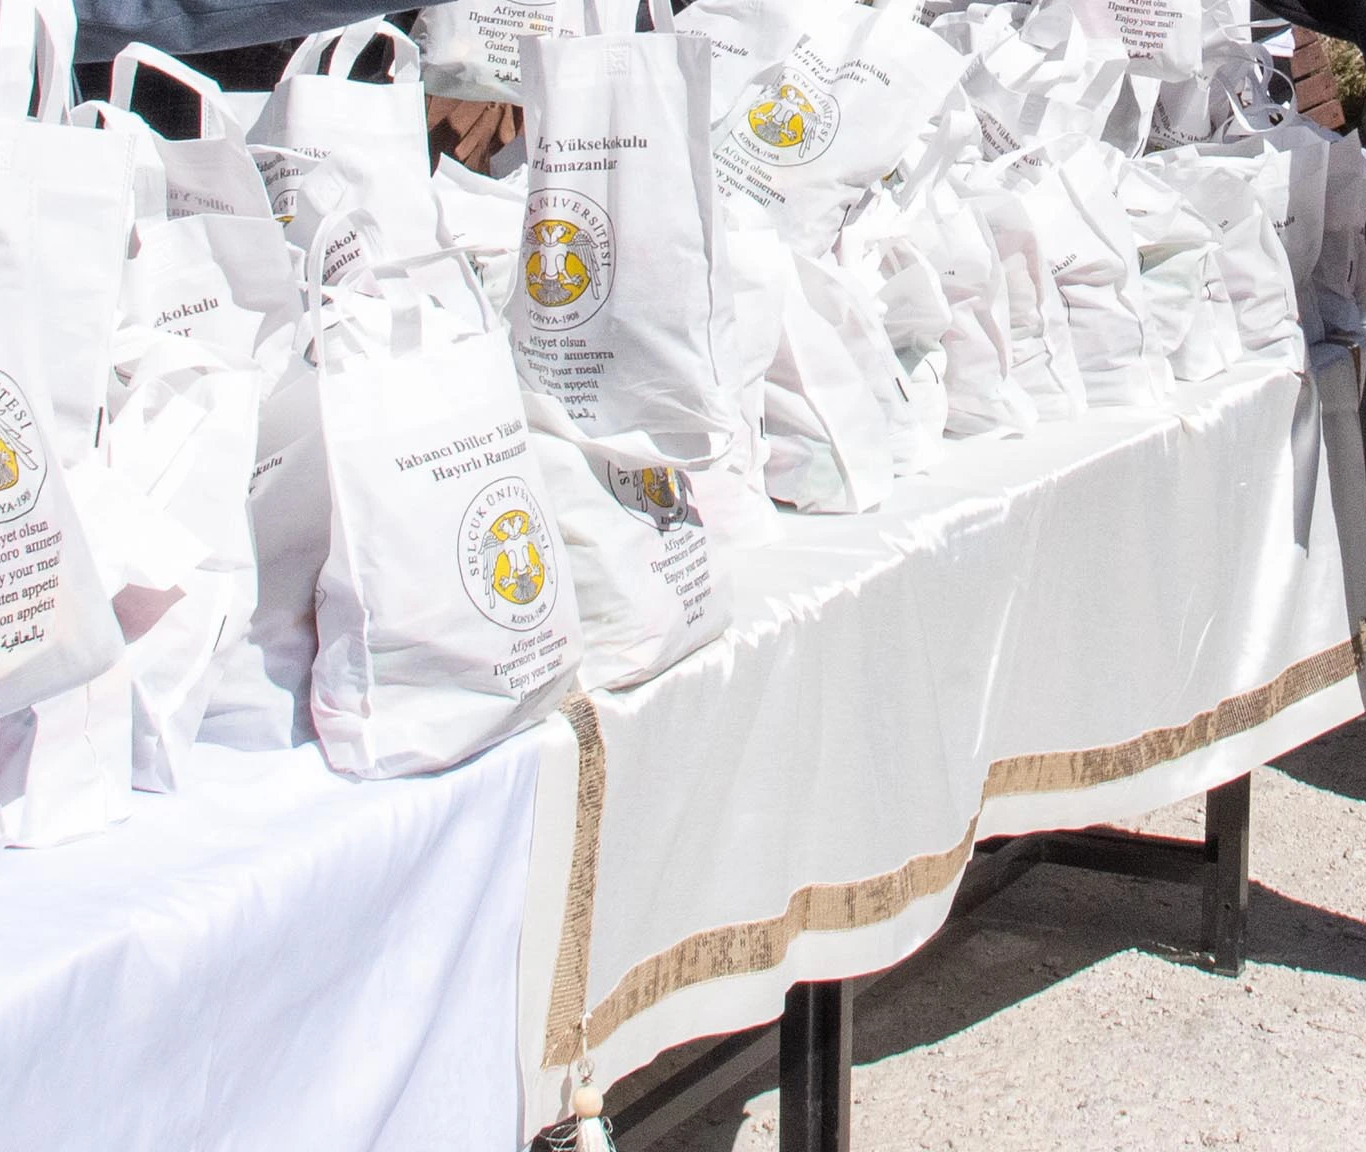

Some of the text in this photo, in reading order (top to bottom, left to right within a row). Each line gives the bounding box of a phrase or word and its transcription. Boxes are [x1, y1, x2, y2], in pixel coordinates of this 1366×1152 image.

[494, 6, 554, 23] Afiyet olsun
[1115, 13, 1138, 26] Enjoy
[478, 26, 508, 40] Enjoy
[485, 40, 515, 53] Guten
[488, 54, 508, 65] Bon
[555, 135, 648, 153] Yüksekokulu
[722, 146, 750, 167] Afiyet
[545, 158, 618, 174] amazanlar
[539, 196, 612, 268] NİVERSİTESİ
[560, 336, 587, 348] olsun
[575, 363, 605, 375] meal!
[564, 378, 599, 391] appetit
[395, 445, 453, 473] Yabancı
[453, 431, 494, 454] Diller
[431, 456, 482, 482] Hayırlı
[19, 520, 49, 538] olsun
[9, 564, 34, 585] your
[17, 598, 55, 622] appétit
[509, 673, 530, 689] Enjoy
